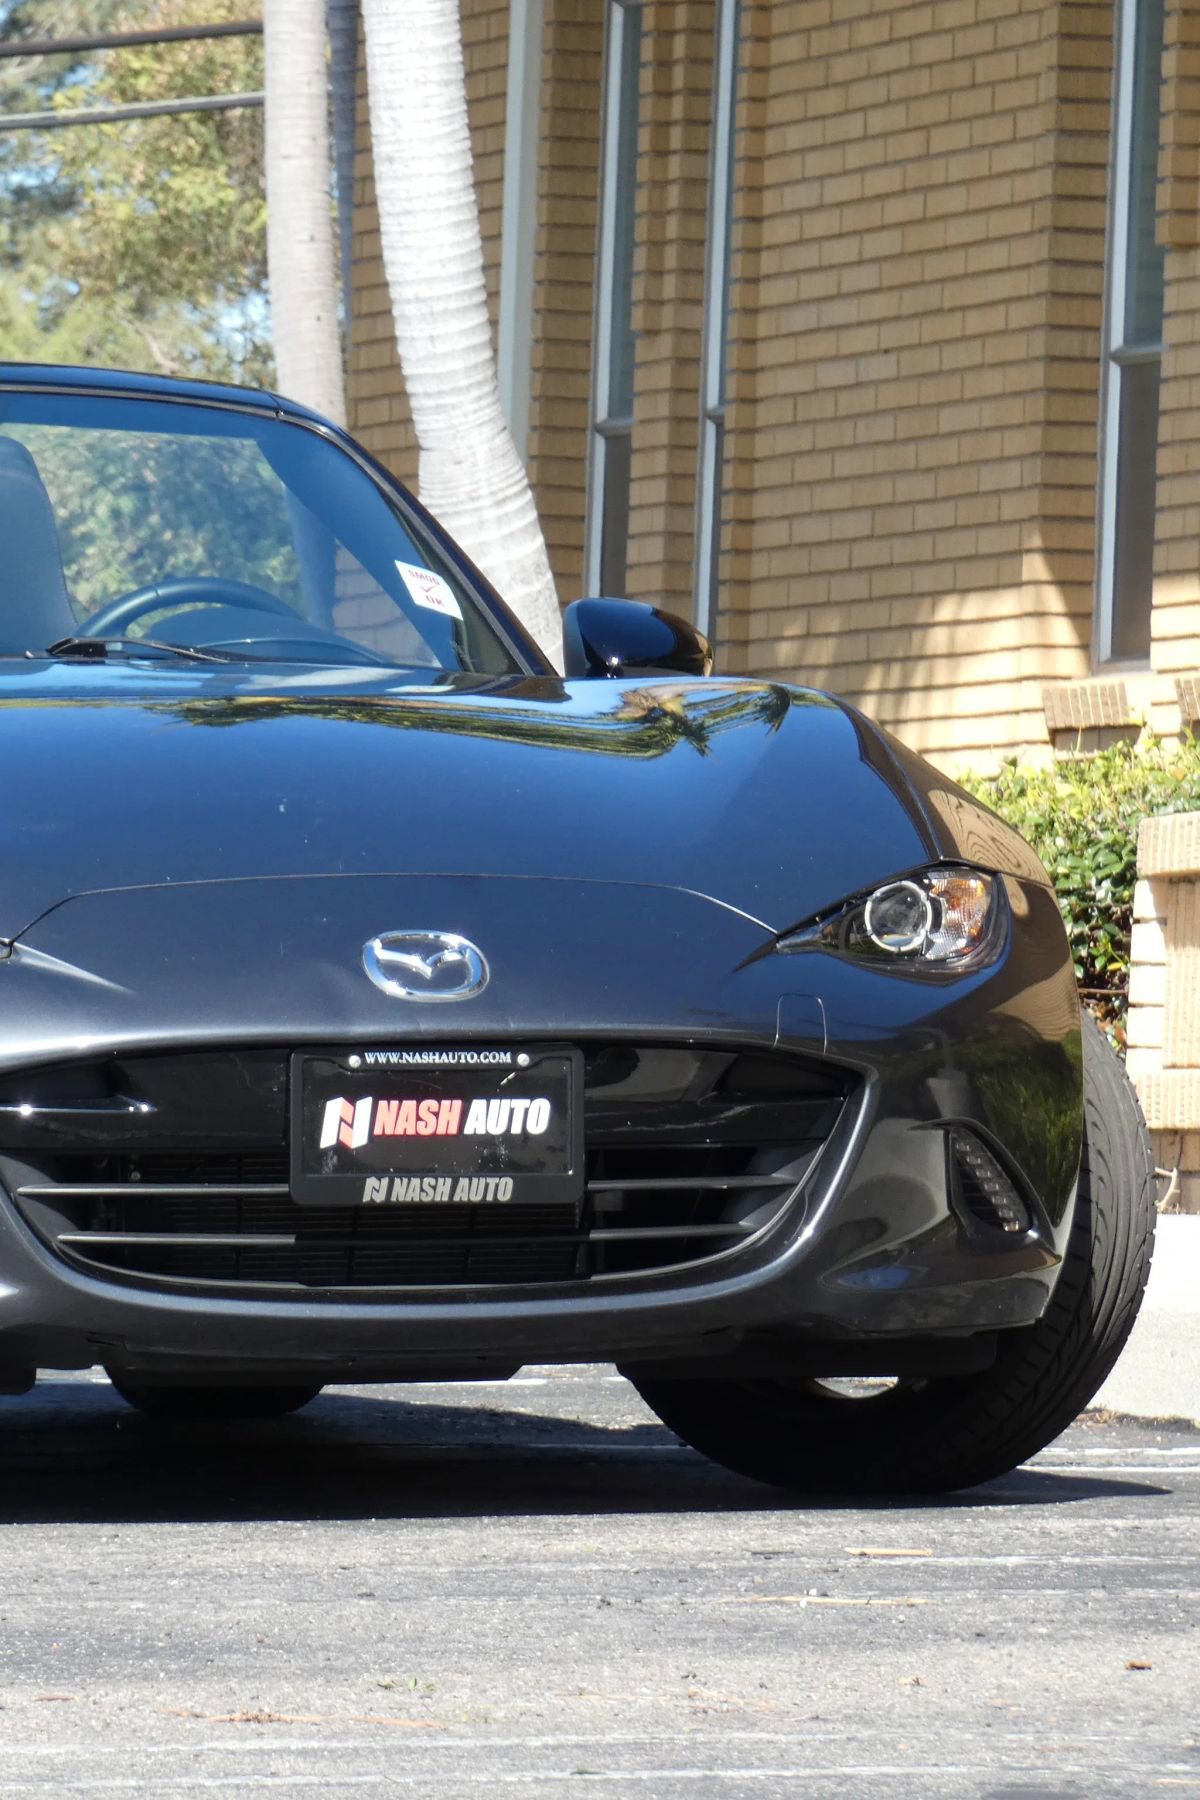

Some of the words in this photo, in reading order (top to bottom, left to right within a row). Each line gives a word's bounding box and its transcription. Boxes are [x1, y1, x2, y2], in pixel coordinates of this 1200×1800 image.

[364, 1051, 512, 1064] WWW.NASHAUTO.COM
[373, 1098, 464, 1136] NASH
[464, 1098, 551, 1136] AUTO
[390, 1176, 450, 1202] NASH
[453, 1176, 514, 1202] AUTO
